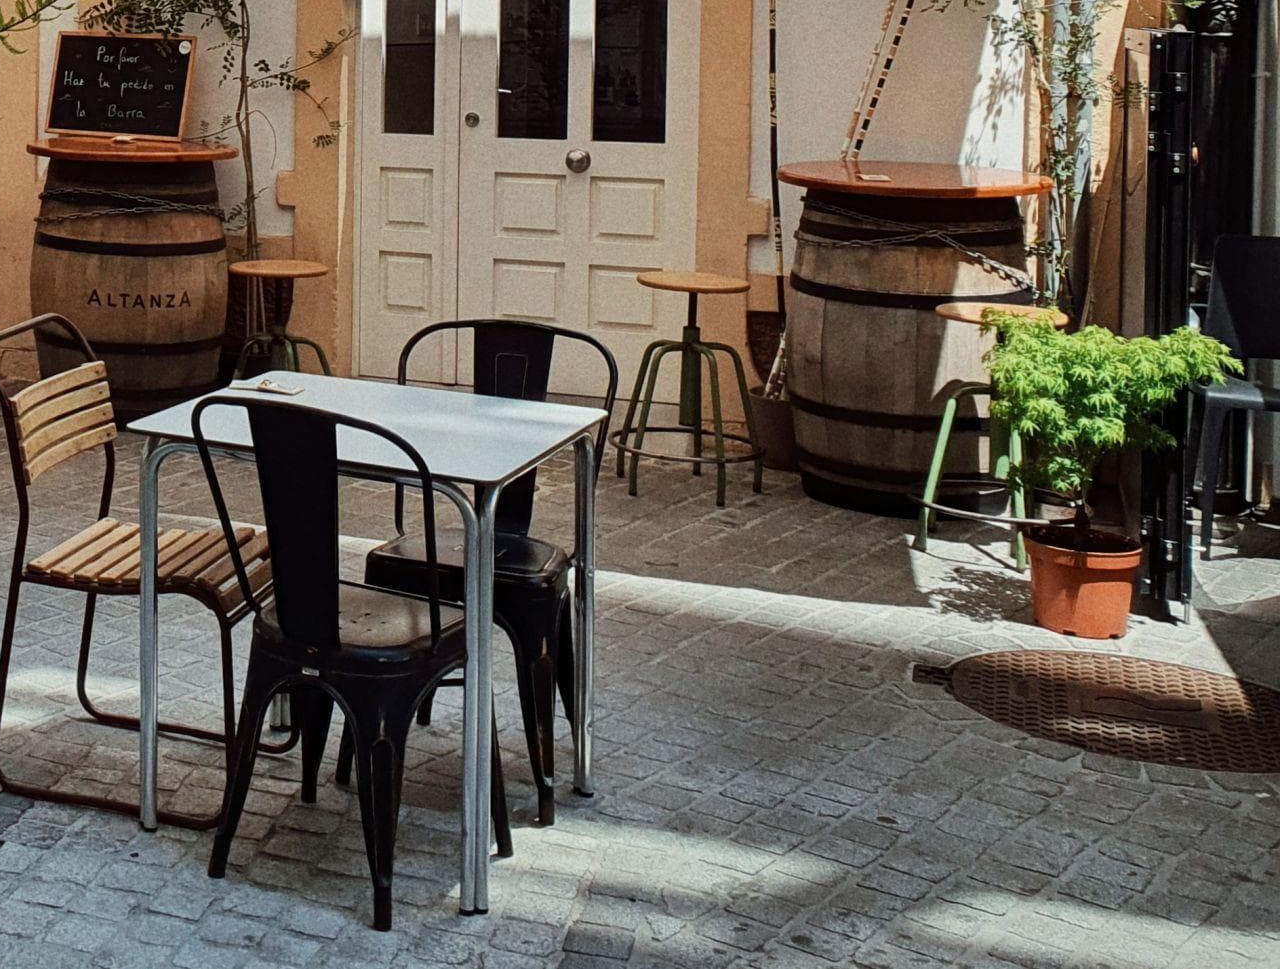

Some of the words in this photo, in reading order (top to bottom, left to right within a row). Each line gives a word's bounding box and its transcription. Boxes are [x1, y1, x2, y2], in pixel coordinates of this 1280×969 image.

[96, 45, 115, 63] Por
[117, 46, 140, 70] favor
[106, 103, 145, 119] Barra
[86, 288, 192, 309] ALTANZA
